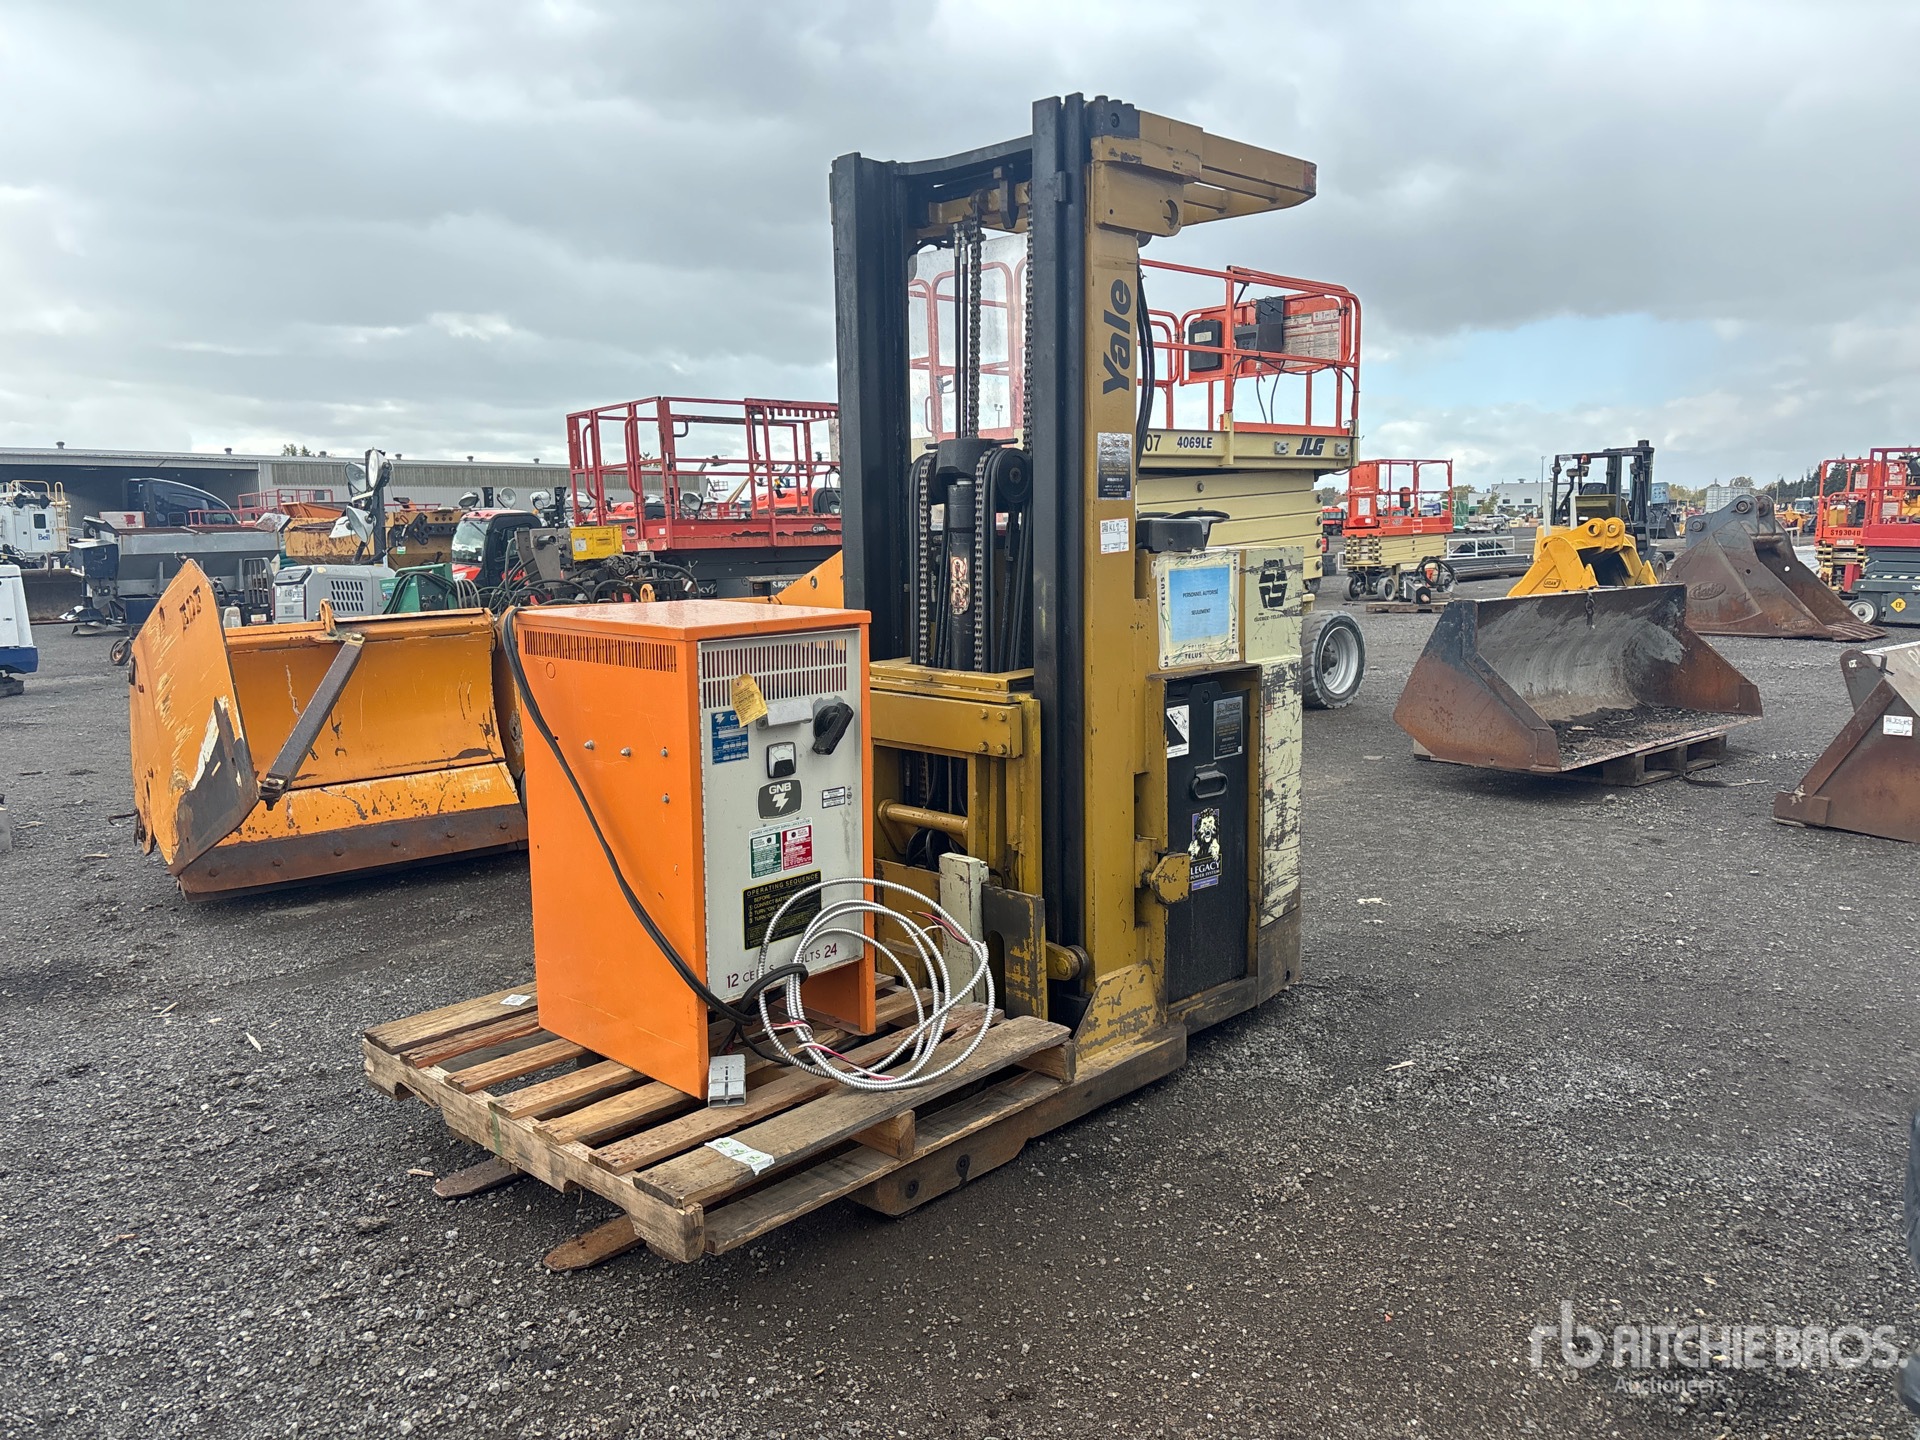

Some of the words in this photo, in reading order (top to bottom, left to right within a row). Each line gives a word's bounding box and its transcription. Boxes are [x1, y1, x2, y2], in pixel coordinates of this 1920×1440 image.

[1102, 278, 1132, 395] Yale
[1176, 436, 1213, 449] 4069LE
[1296, 437, 1326, 456] JLG
[38, 533, 51, 541] Bell
[768, 782, 792, 795] GNB
[1190, 860, 1220, 875] LEGACY
[1190, 872, 1205, 881] POWER
[746, 881, 784, 897] OPERATING
[785, 872, 819, 887] SEQUENCE
[754, 899, 775, 909] CONNECT
[824, 942, 838, 959] 24
[726, 973, 739, 989] 12
